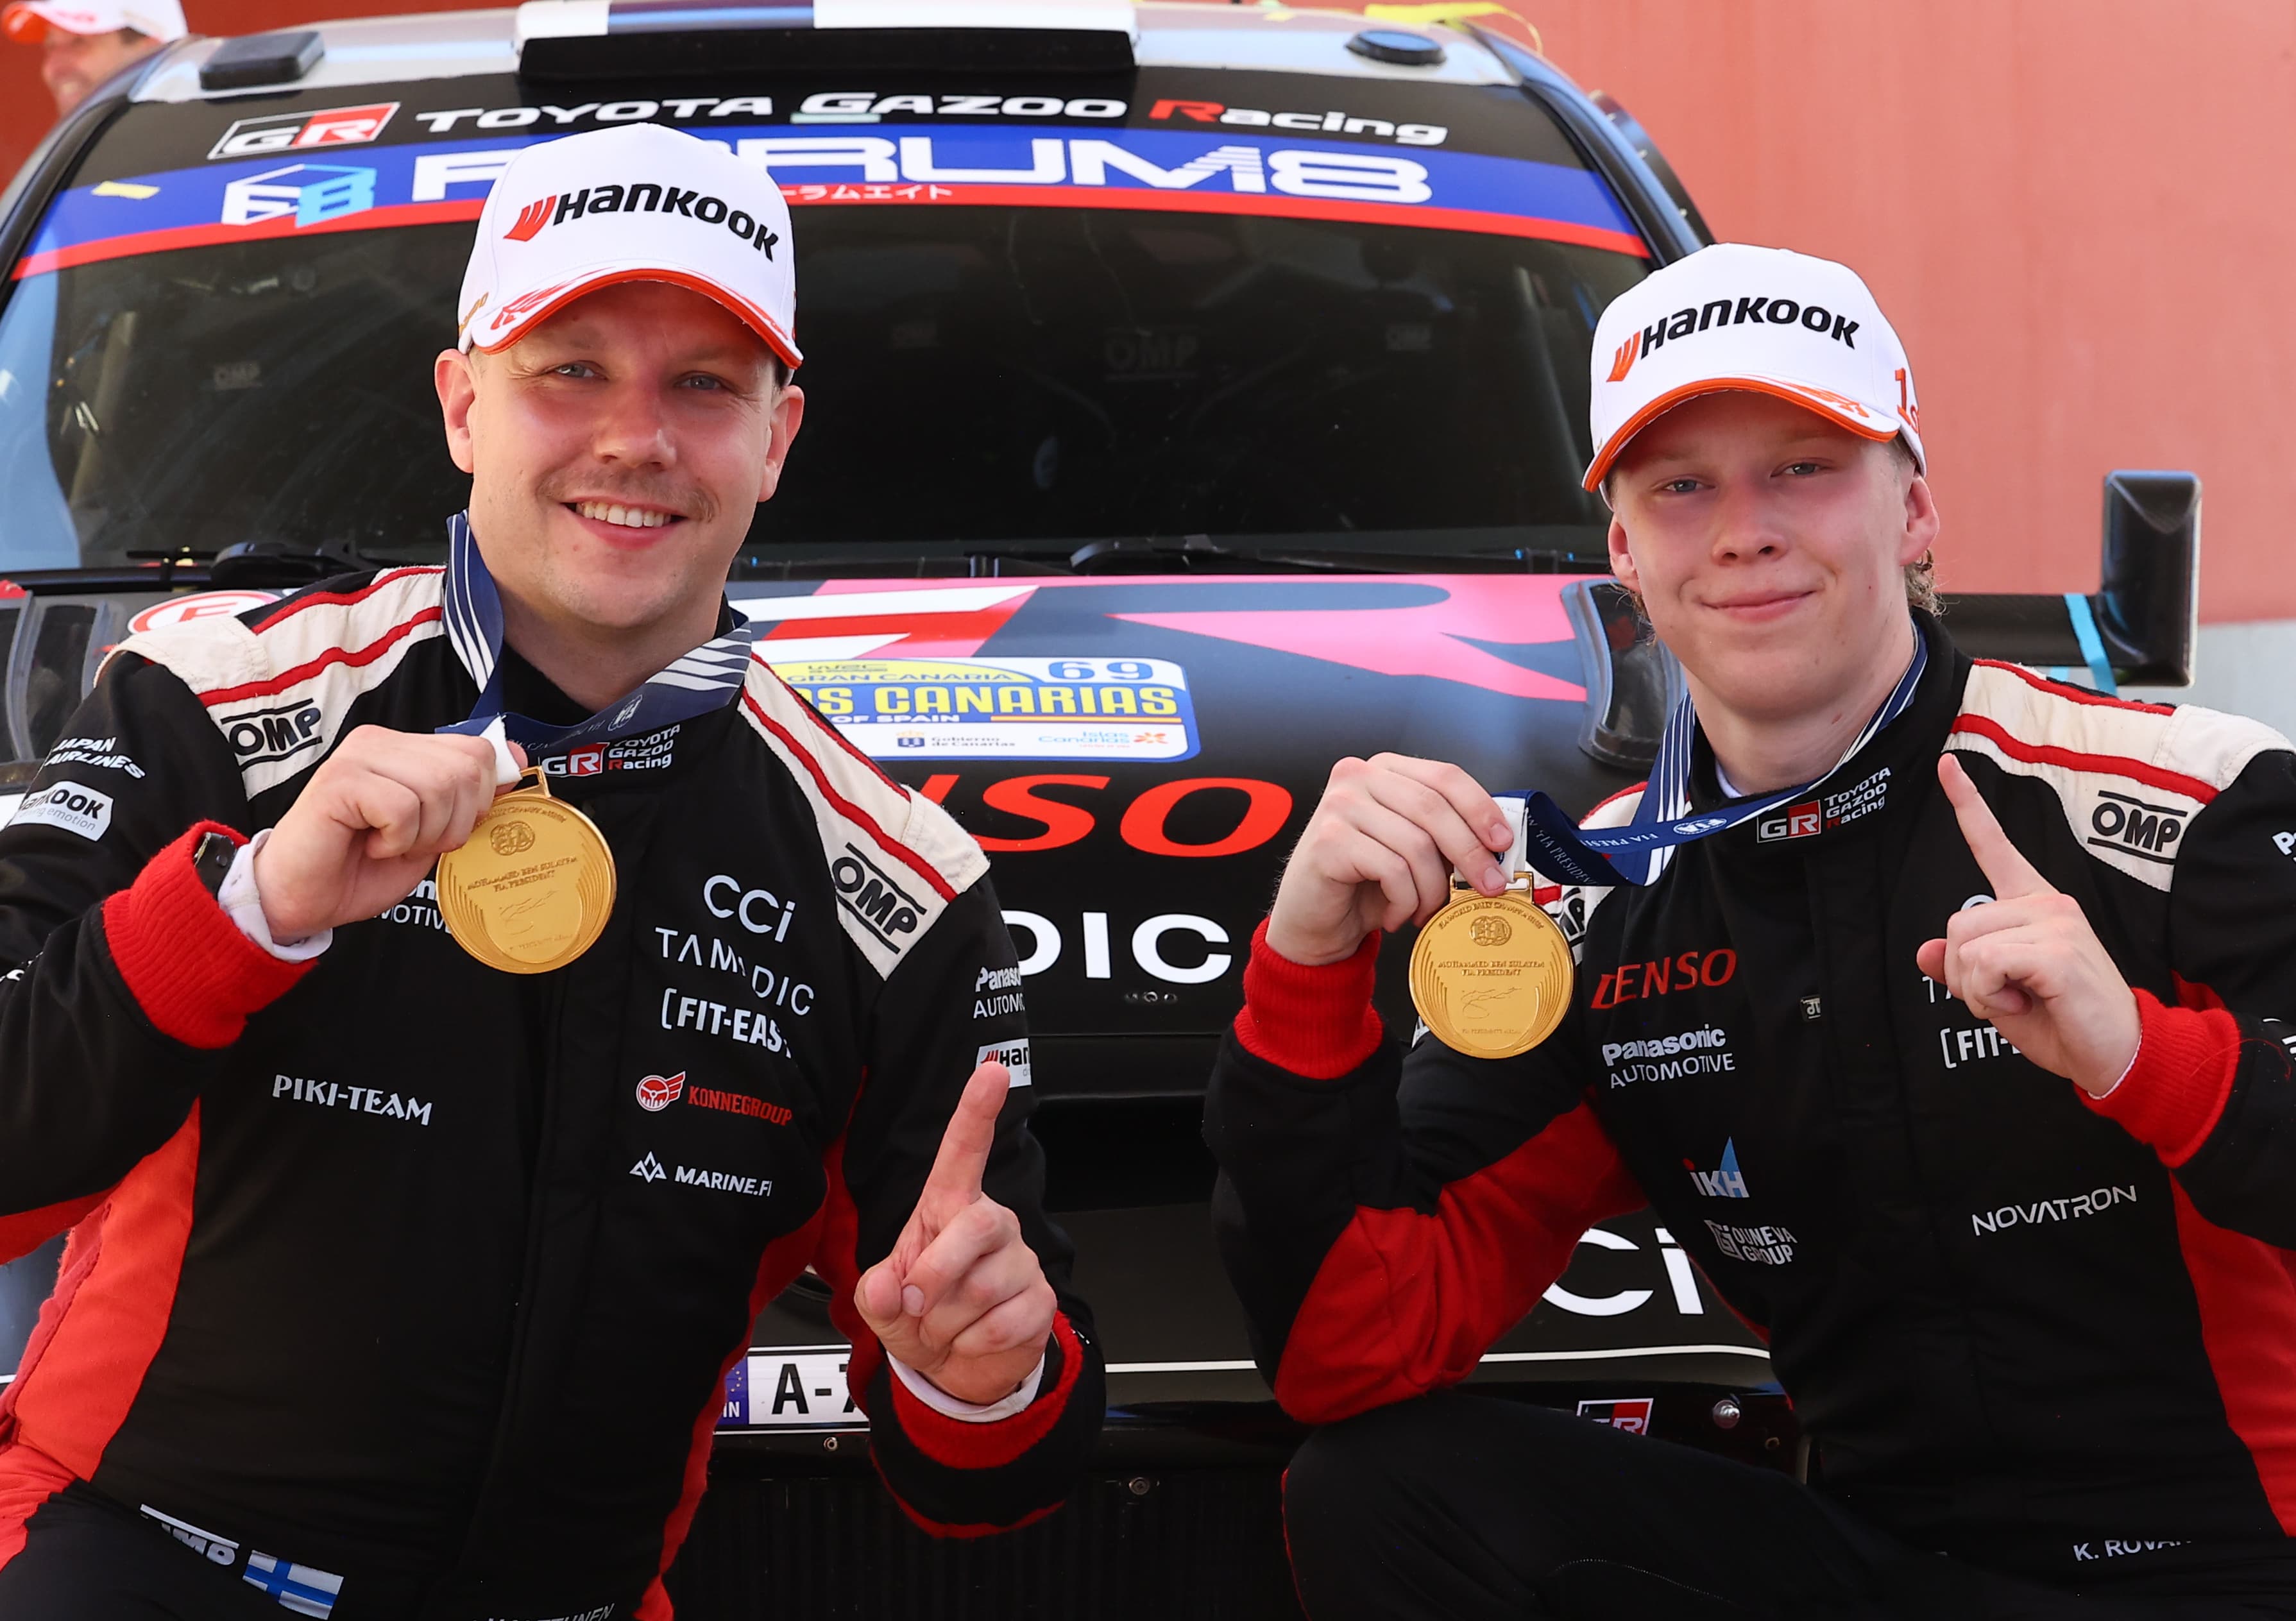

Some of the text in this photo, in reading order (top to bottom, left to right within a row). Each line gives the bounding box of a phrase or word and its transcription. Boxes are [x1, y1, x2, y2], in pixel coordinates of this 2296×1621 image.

[222, 116, 378, 155] GR
[416, 92, 1449, 145] TOYOTA GAZOO Racing
[412, 135, 1433, 204] FRUM8
[879, 673, 1013, 682] CANARIA
[874, 686, 1177, 715] CANARIAS
[229, 708, 321, 756] OMP
[876, 715, 960, 723] SPAIN
[51, 737, 117, 752] JAPAN
[609, 739, 674, 759] GAZOO
[609, 752, 672, 770] Racing
[44, 751, 146, 779] AIRLINES
[541, 751, 601, 776] GR
[1824, 767, 1892, 808] TOYOTA
[1826, 782, 1887, 819] GAZOO
[47, 807, 96, 831] emotion
[1760, 813, 1818, 839] GR
[1827, 795, 1885, 829] Racing
[2092, 802, 2181, 853] OMP
[831, 857, 917, 936] OMP
[1603, 1024, 1726, 1066] Panasonic
[1610, 1053, 1736, 1089] AUTOMOTIVE
[273, 1074, 432, 1126] PIKI-TEAM
[688, 1085, 792, 1126] KONNEGROUP
[674, 1166, 772, 1197] MARINE.FI
[1972, 1185, 2138, 1236] NOVATRON
[2073, 1542, 2100, 1561] K.
